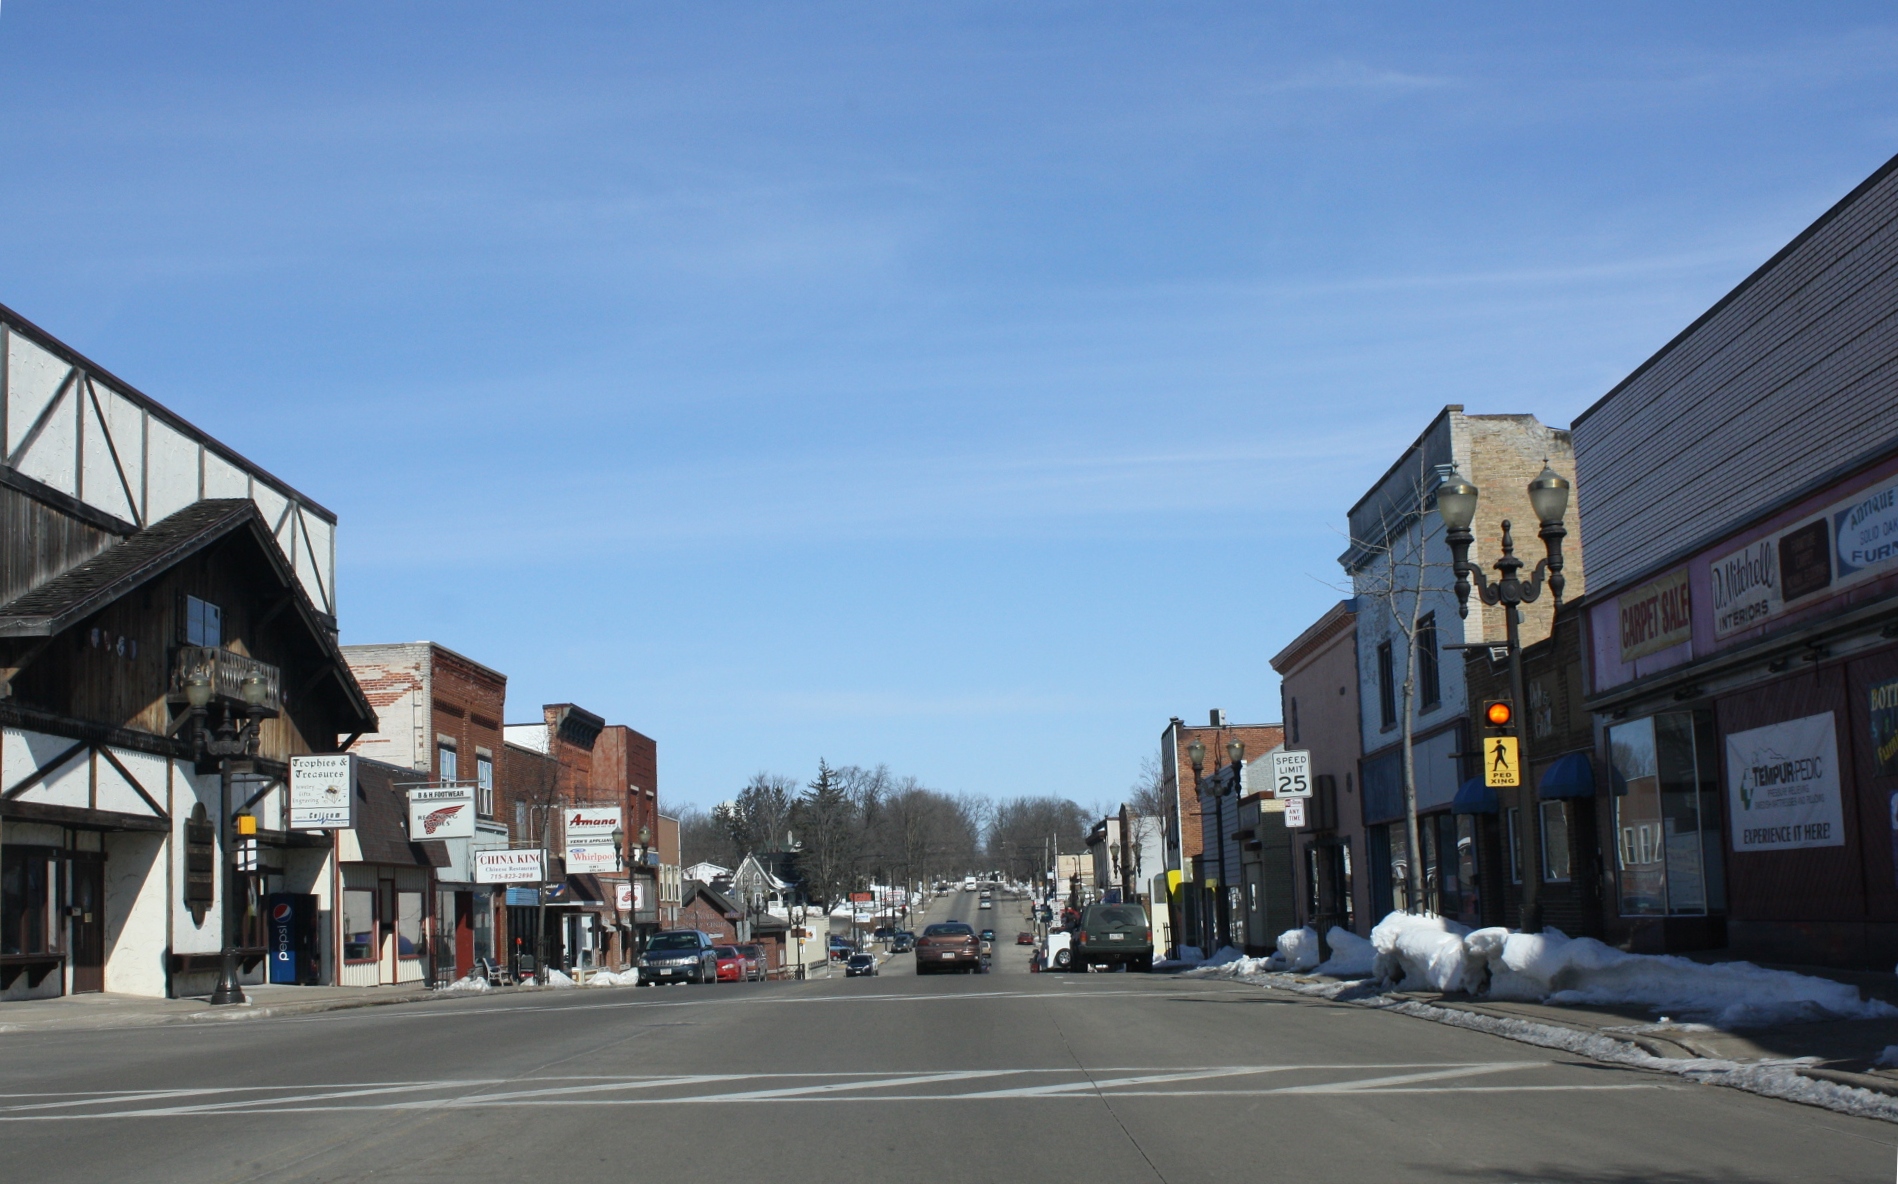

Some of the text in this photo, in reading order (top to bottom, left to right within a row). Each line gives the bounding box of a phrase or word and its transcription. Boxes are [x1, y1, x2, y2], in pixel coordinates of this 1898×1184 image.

[1850, 489, 1894, 530] ANTIQUE
[1859, 525, 1879, 546] SOLID
[1723, 541, 1774, 607] Mitchell
[1621, 582, 1689, 649] CARPET SALE
[1719, 599, 1769, 632] INTERIORS
[292, 758, 347, 768] Trophies &
[1275, 755, 1307, 765] SPEED
[295, 769, 344, 779] Treasures
[1279, 765, 1303, 774] LIMIT
[1278, 775, 1307, 793] 25
[434, 790, 464, 798] FOOTWEAR
[569, 813, 617, 826] Amana
[1743, 822, 1830, 845] EXPERIENCE IT HERE!
[480, 854, 514, 865] CHINA
[573, 852, 615, 862] Whirlpool
[278, 925, 289, 961] pepsi
